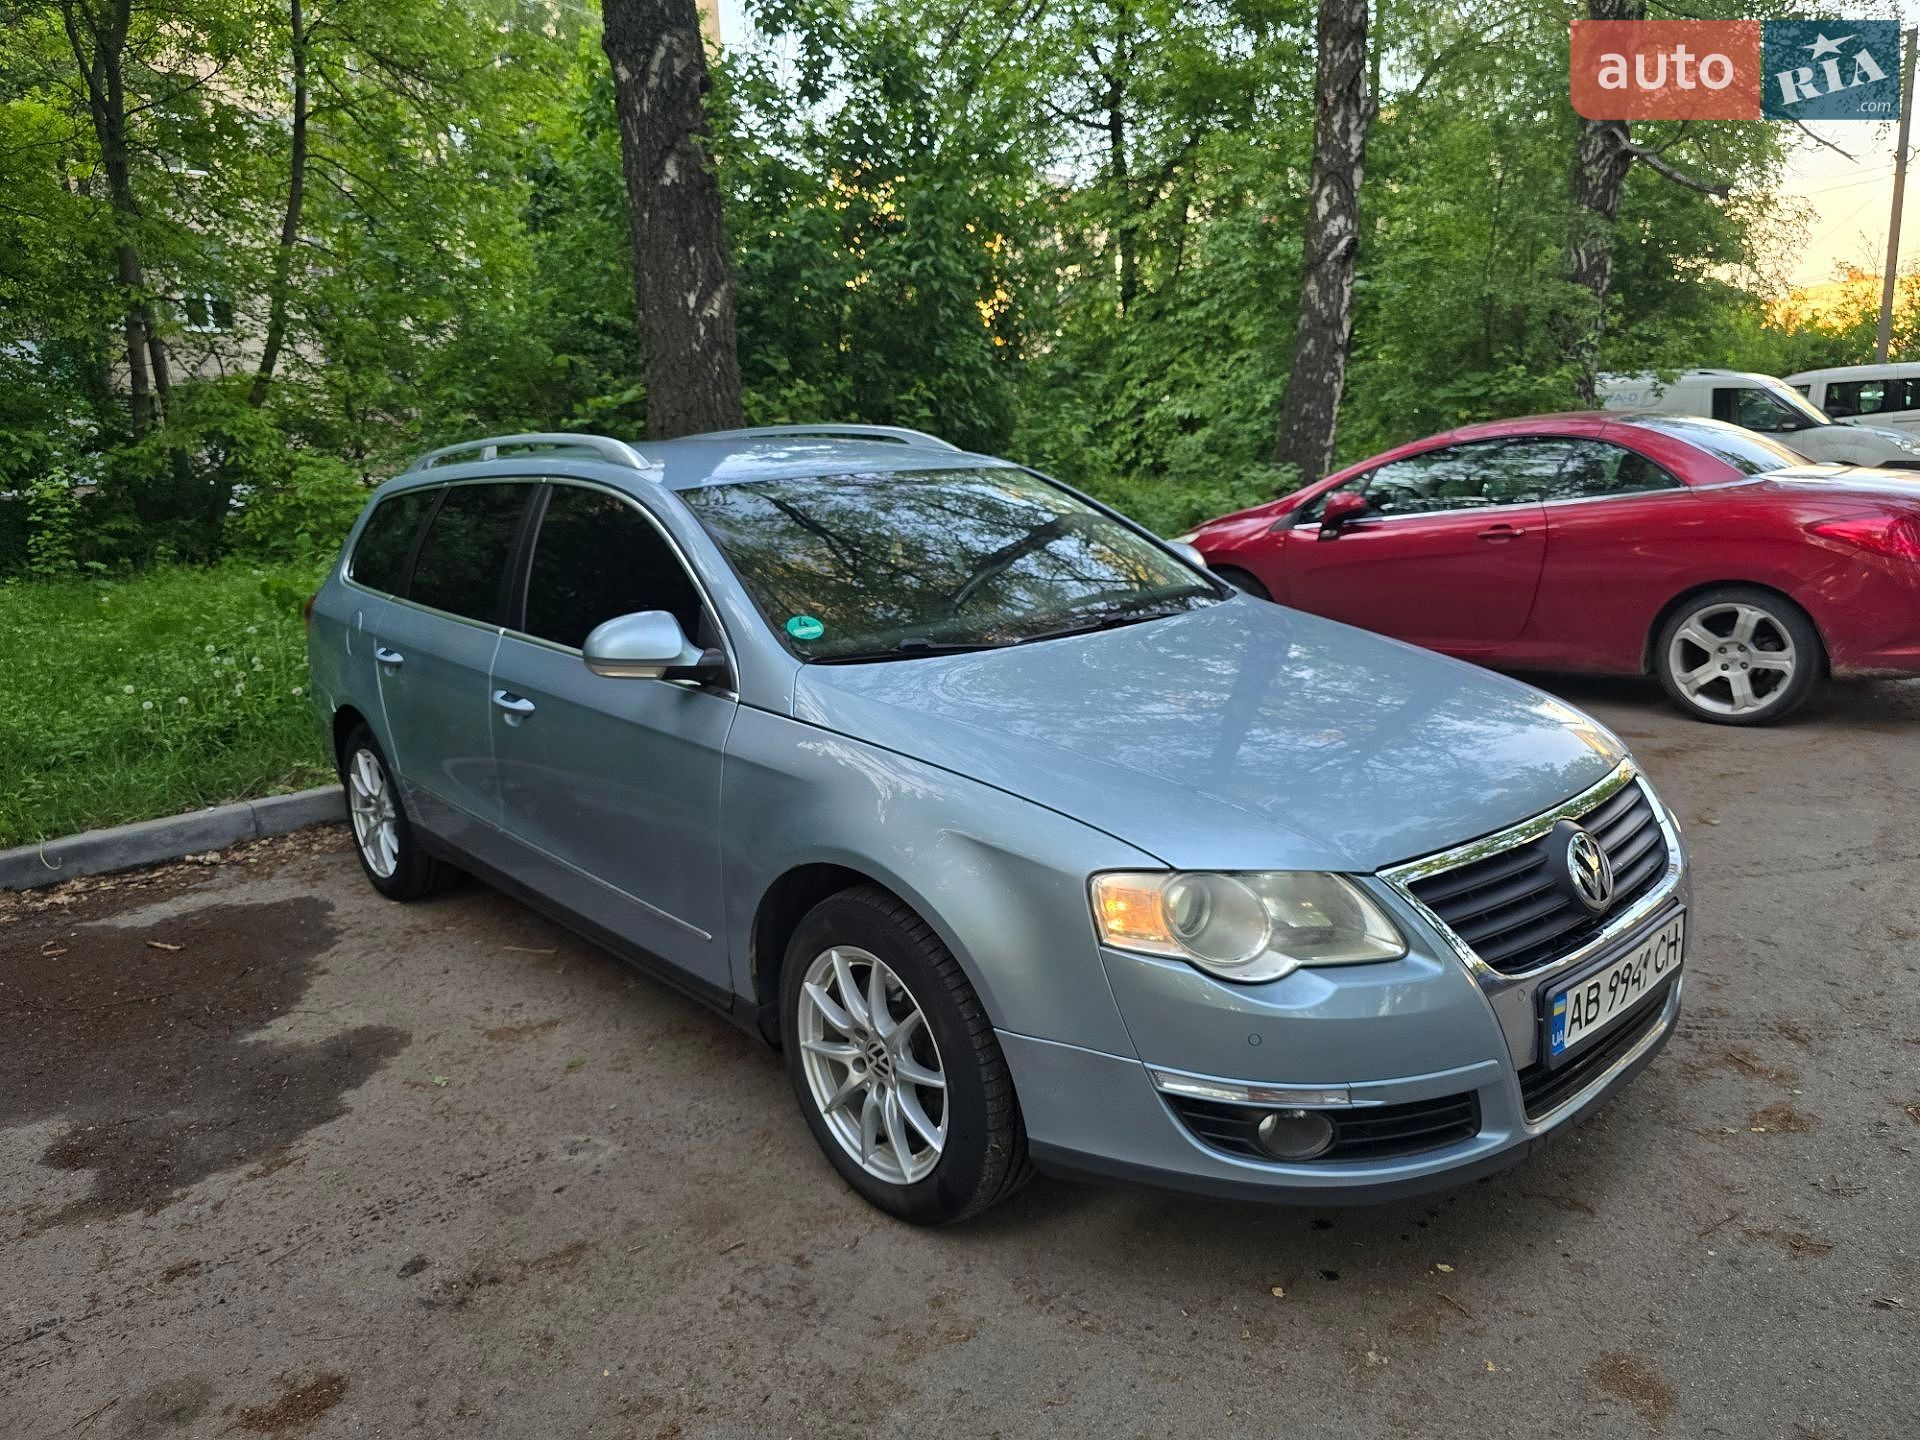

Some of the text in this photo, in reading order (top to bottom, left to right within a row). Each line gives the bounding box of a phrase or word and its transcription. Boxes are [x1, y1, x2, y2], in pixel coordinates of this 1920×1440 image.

[1567, 982, 1601, 1037] AB
[1655, 923, 1679, 973] CH
[1552, 1030, 1564, 1046] UA
